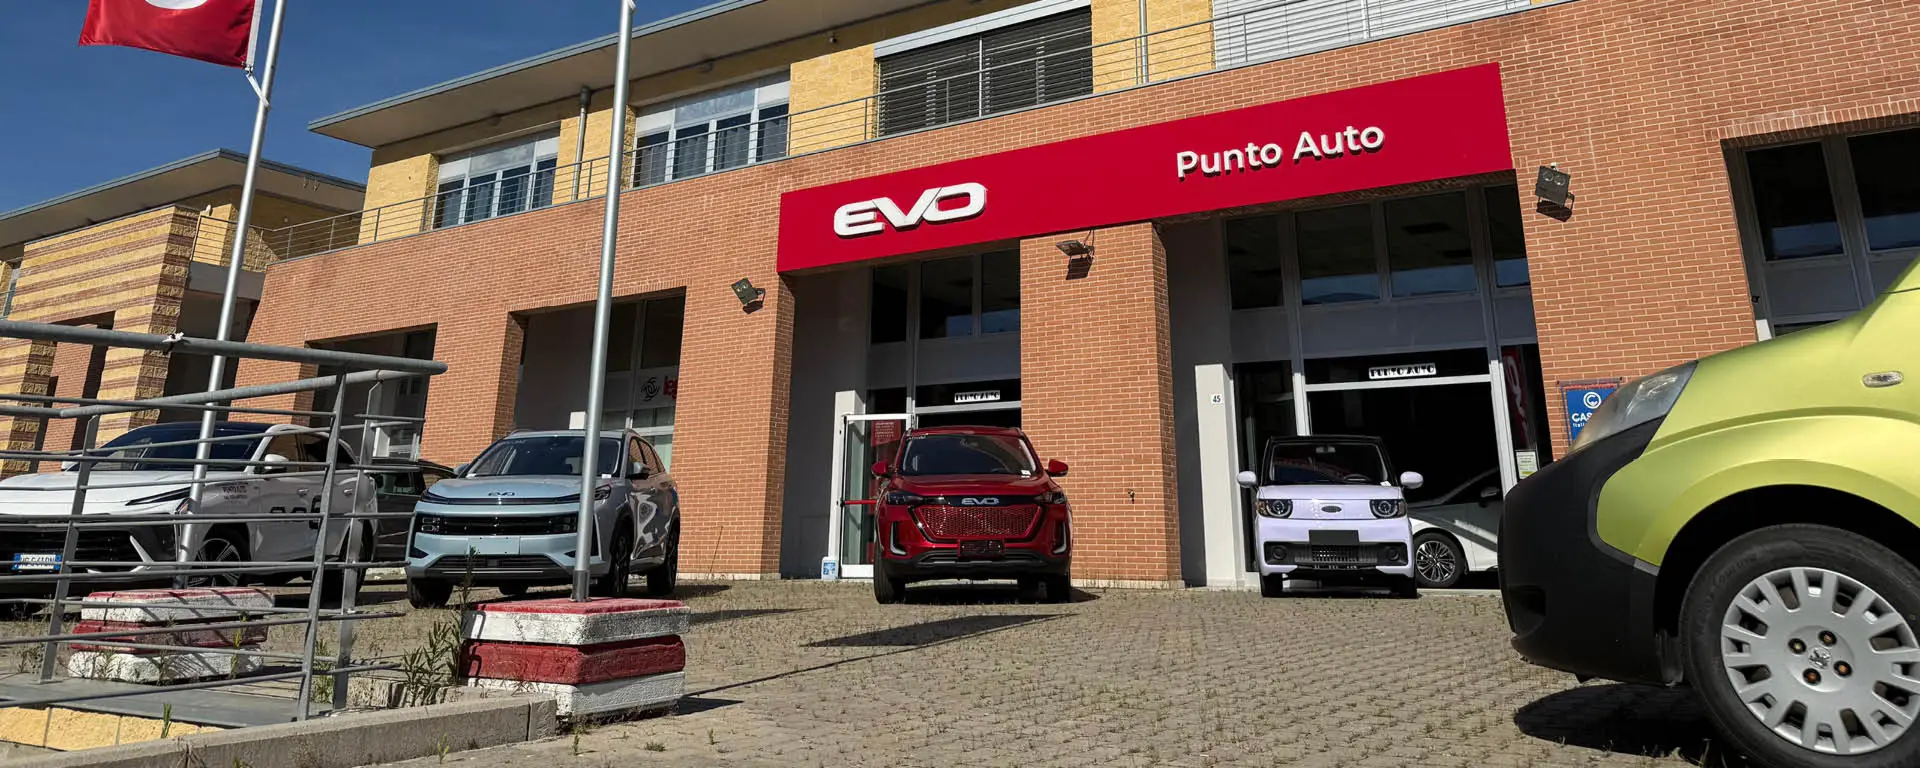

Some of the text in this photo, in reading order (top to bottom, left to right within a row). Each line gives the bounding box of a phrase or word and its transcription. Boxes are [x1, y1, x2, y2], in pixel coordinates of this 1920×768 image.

[1176, 125, 1385, 181] Punto Auto
[833, 182, 988, 238] EVO
[1212, 395, 1221, 403] 45
[961, 497, 1000, 505] EVO
